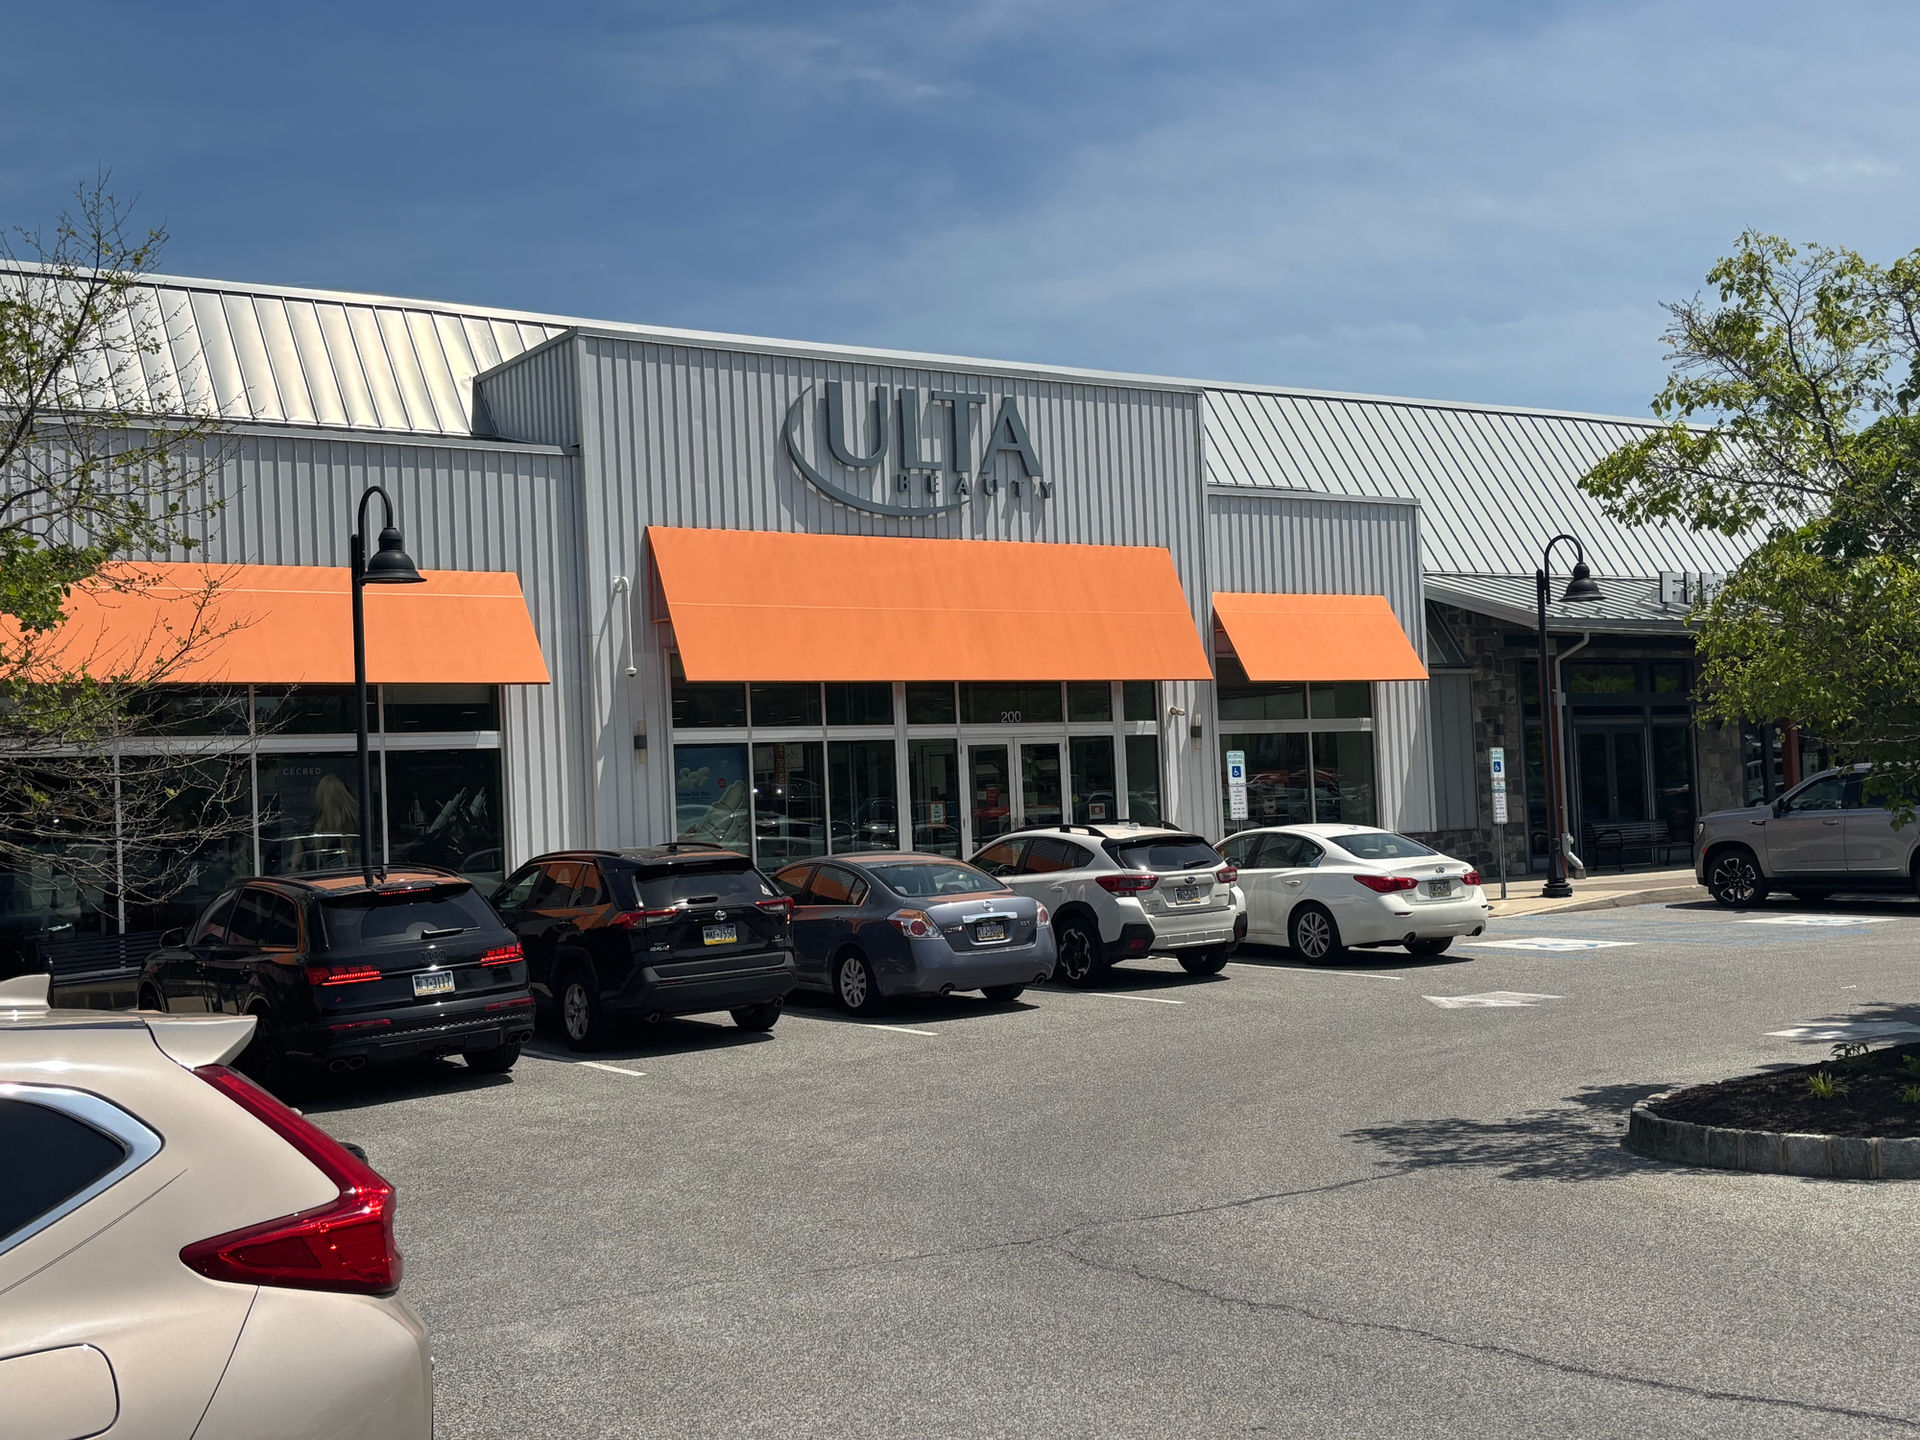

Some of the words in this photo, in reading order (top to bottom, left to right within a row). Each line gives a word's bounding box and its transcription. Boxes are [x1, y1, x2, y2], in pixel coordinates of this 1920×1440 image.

[825, 381, 1043, 476] ULTA
[897, 473, 1054, 499] BEAUTY
[1001, 710, 1021, 723] 200
